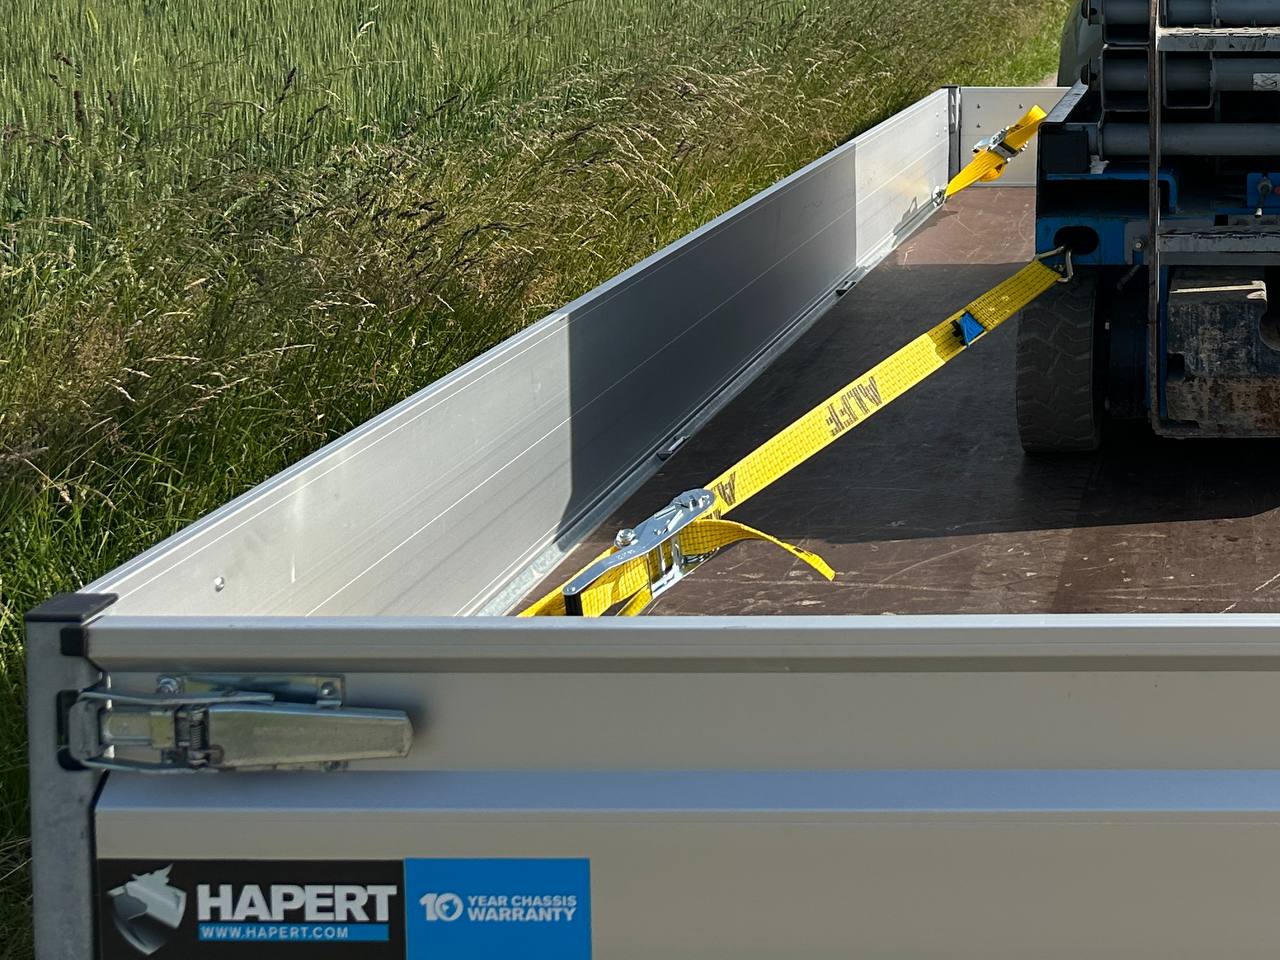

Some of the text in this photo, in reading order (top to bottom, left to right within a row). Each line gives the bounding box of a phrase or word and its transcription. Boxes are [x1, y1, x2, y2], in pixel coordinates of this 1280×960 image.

[825, 376, 882, 436] ALFF
[197, 884, 397, 921] HAPERT
[419, 893, 577, 921] 10 YEAR CHASSIS
[468, 908, 577, 921] WARRANTY
[201, 926, 348, 938] WWW.HAPERT.COM
